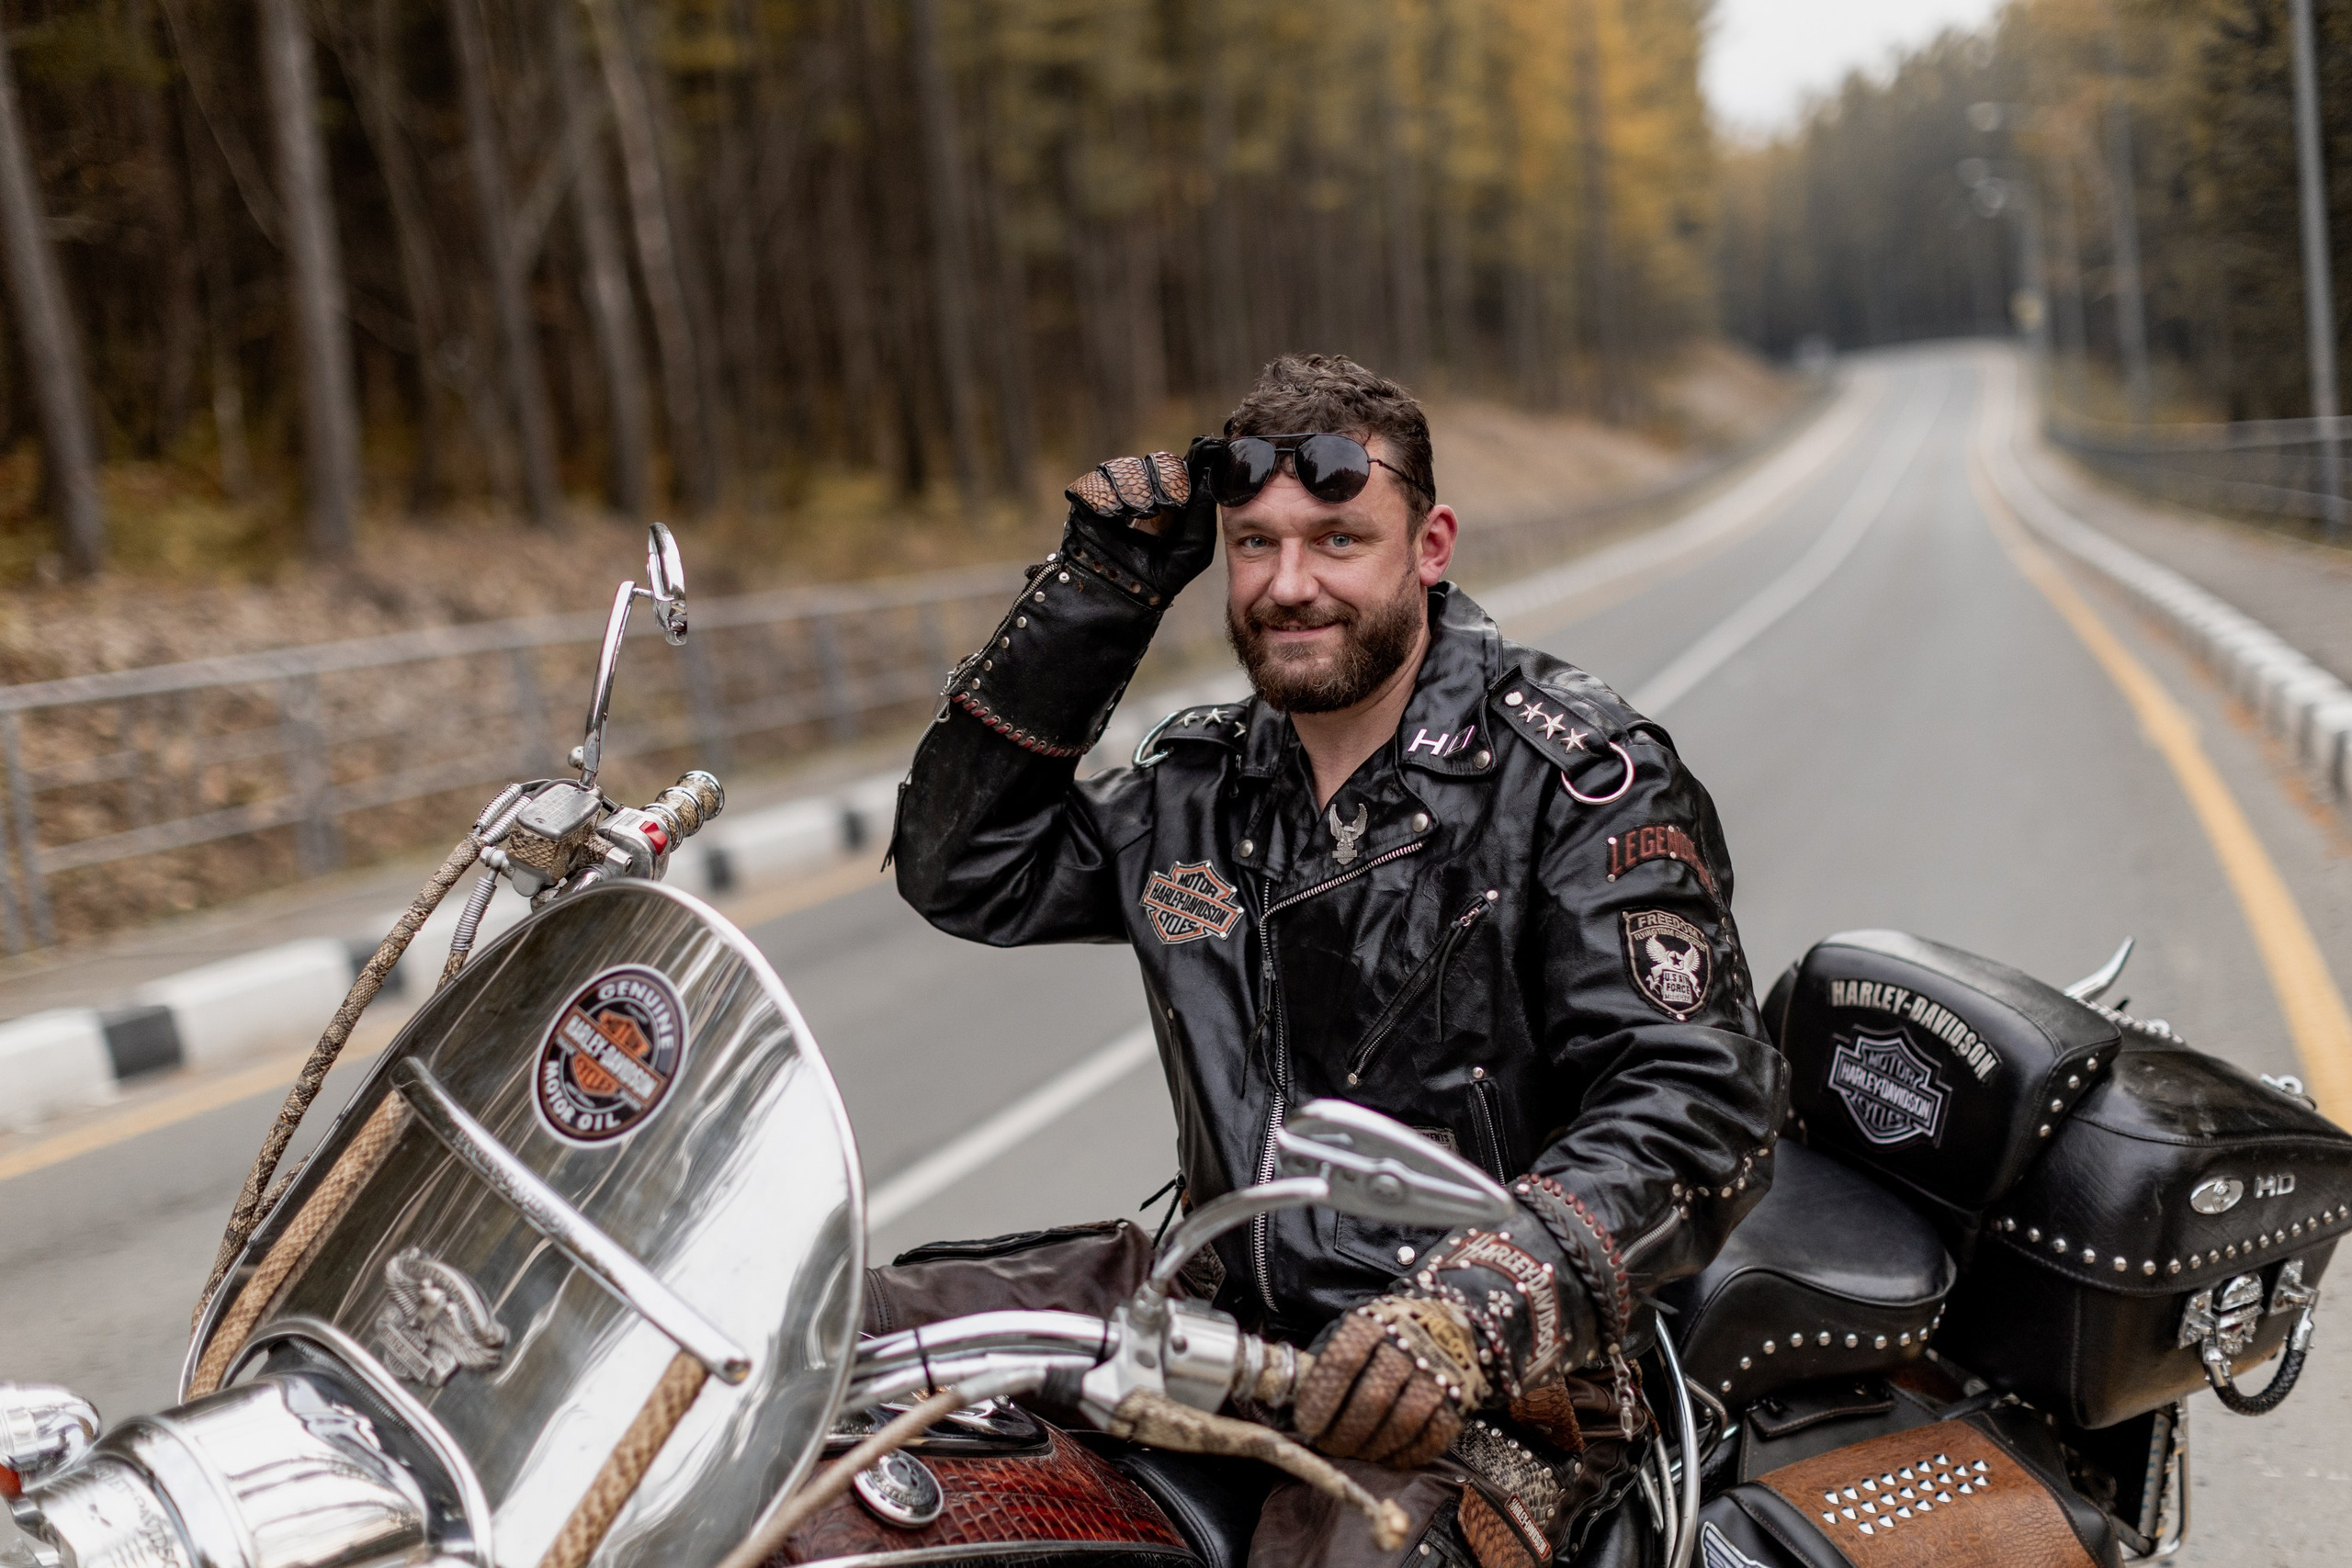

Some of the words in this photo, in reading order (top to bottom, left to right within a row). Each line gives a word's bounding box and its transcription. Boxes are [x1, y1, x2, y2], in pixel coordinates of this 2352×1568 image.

[1177, 872, 1218, 898] MOTOR
[1149, 883, 1229, 927] HARLEY-DAVIDSON
[1159, 909, 1199, 936] CYCLES
[1637, 912, 1700, 940] FREEDOM
[1666, 983, 1690, 995] FORCE
[598, 981, 673, 1049] GENUINE
[1831, 980, 1997, 1080] HARLEY-DAVIDSON
[563, 1014, 659, 1100] HARLEY-DAVIDSON
[1868, 1052, 1916, 1086] MOTOR
[544, 1060, 576, 1123] MOTOR
[577, 1111, 622, 1131] OIL
[1840, 1061, 1930, 1120] HARLEY-DAVIDSON
[1858, 1096, 1905, 1130] CYCLES
[2255, 1174, 2296, 1199] HD
[1508, 1497, 1548, 1555] HARLEY-DAVIDSON
